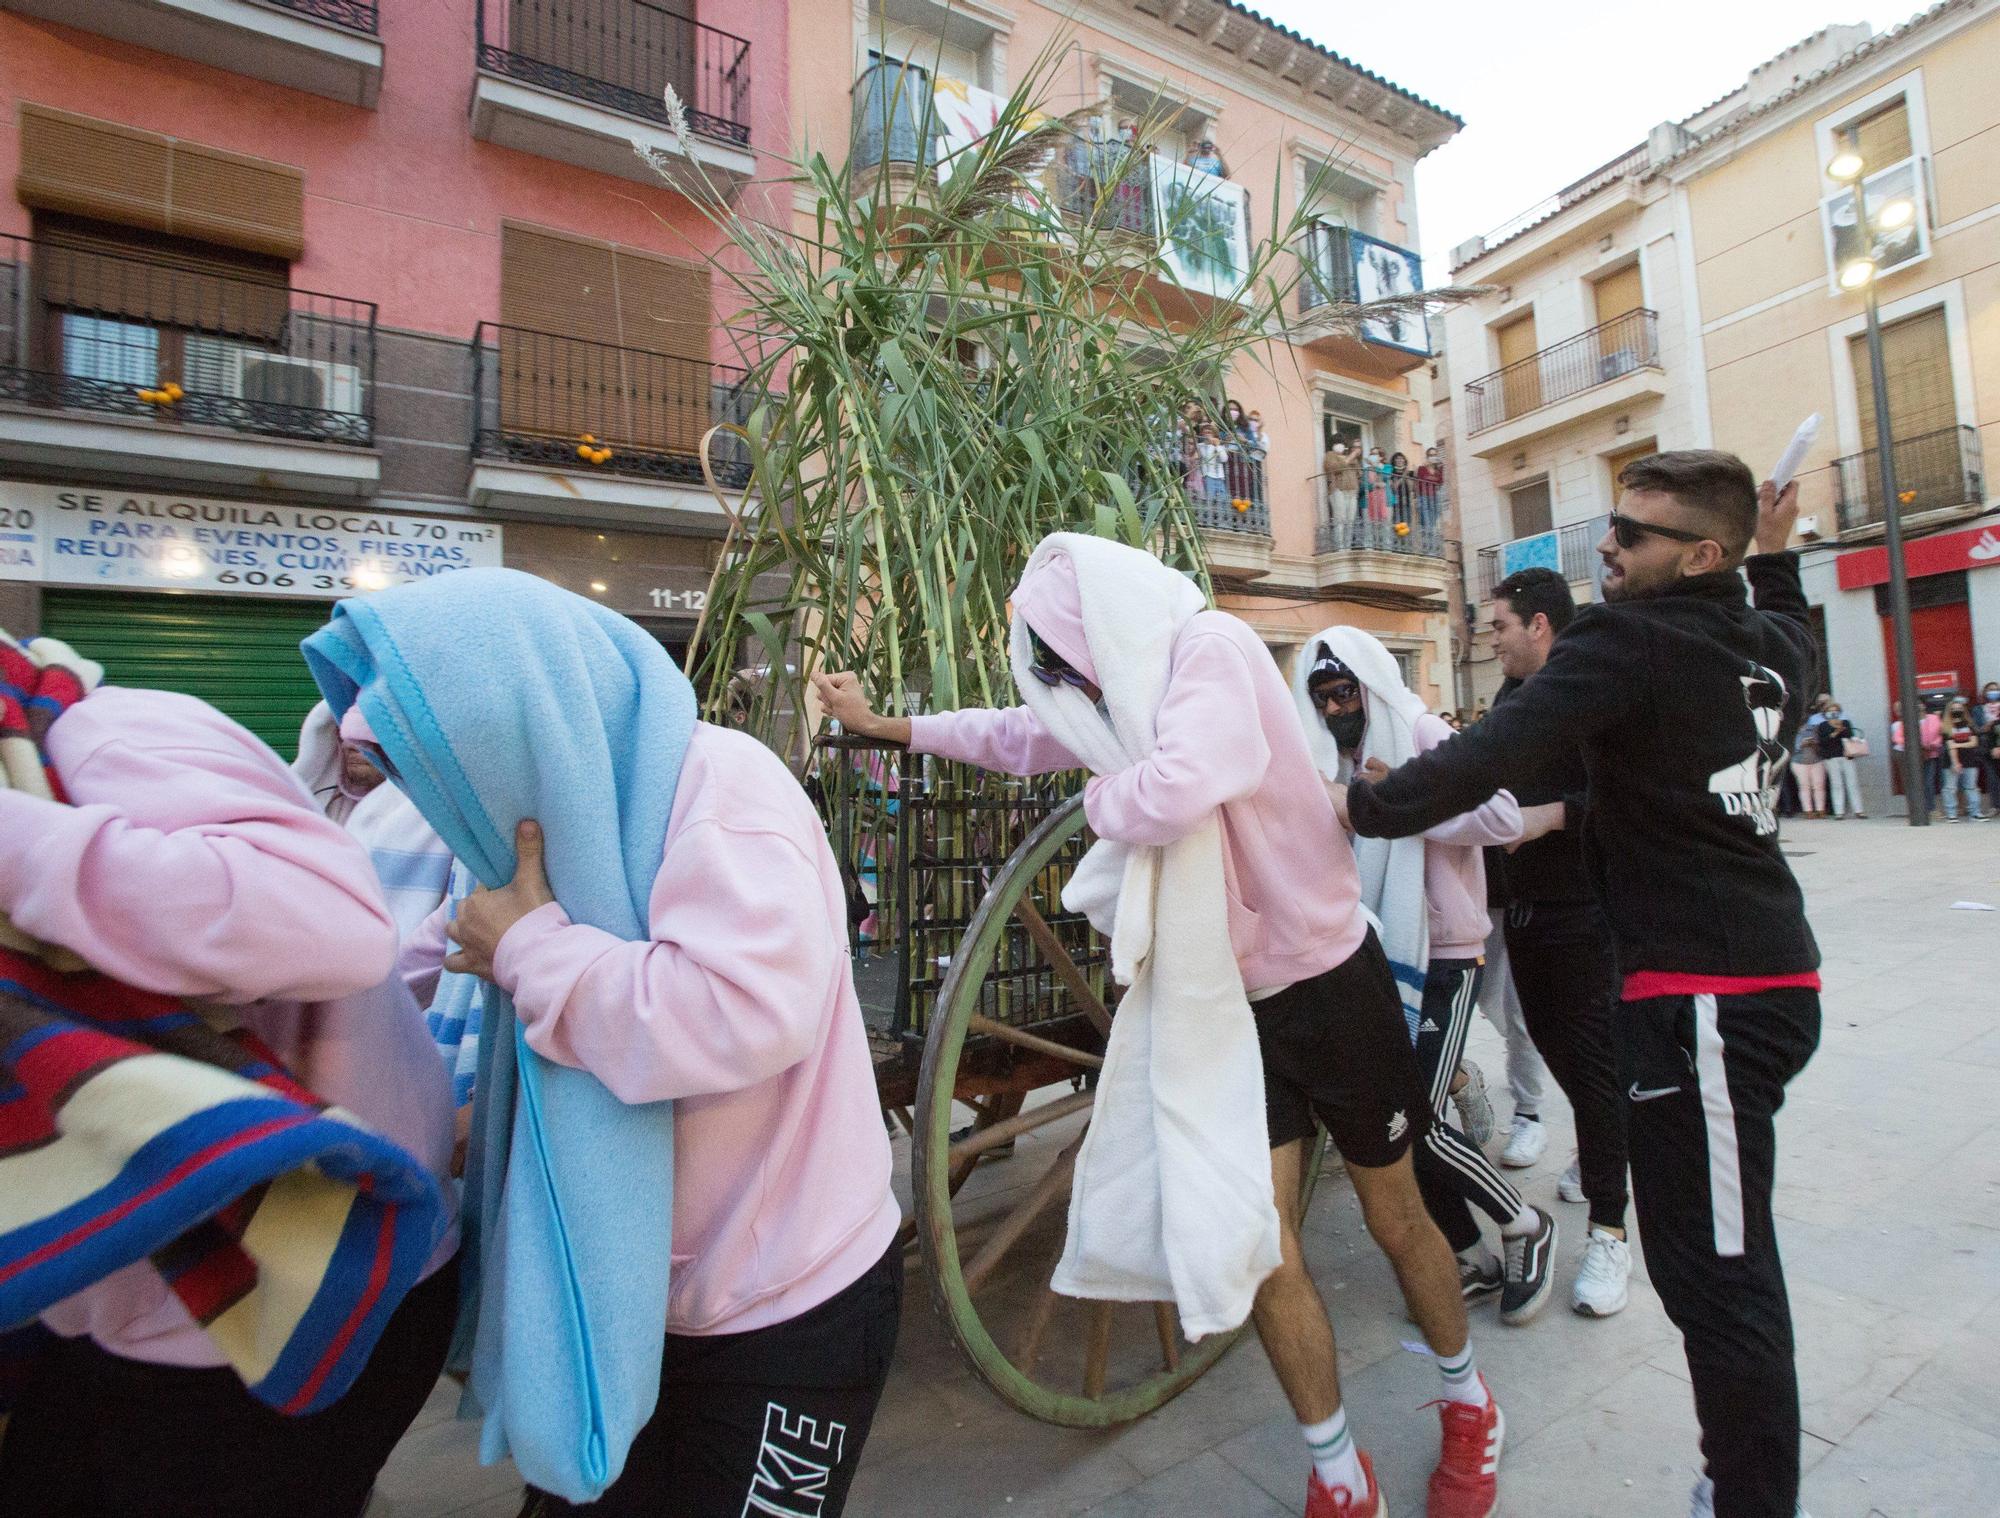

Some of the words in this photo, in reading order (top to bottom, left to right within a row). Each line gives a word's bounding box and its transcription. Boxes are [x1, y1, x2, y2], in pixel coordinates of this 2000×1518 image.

[57, 493, 102, 512] SE
[118, 499, 282, 527] ALQUILA
[295, 513, 402, 536] LOCAL
[411, 523, 448, 540] 70
[90, 519, 178, 539] PARA
[194, 526, 347, 555] EVENTOS,
[359, 540, 471, 563] FIESTAS,
[217, 570, 294, 587] 606
[649, 588, 707, 609] 11-12
